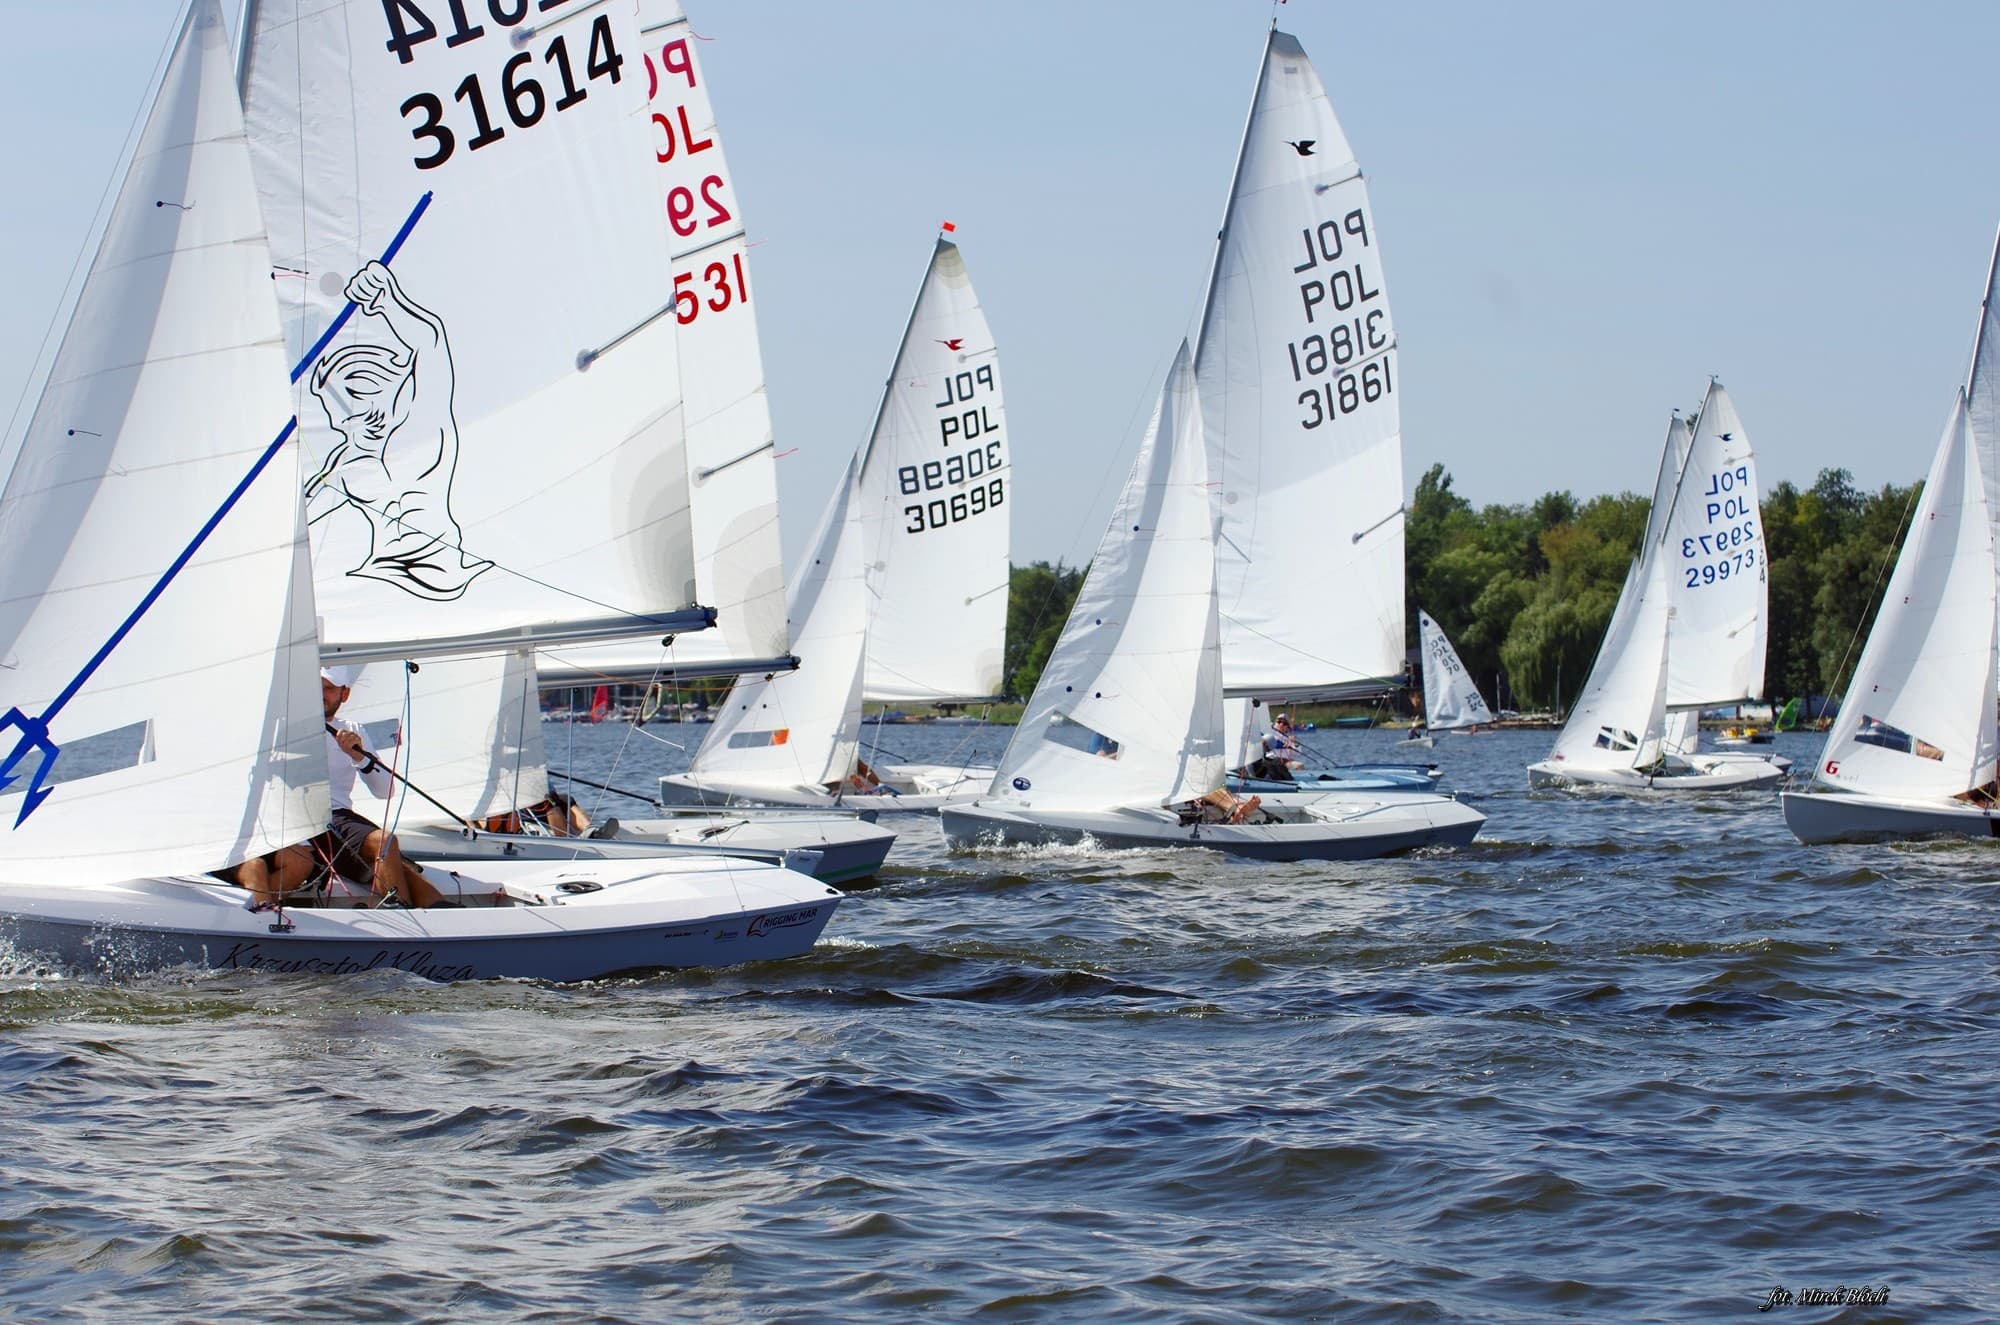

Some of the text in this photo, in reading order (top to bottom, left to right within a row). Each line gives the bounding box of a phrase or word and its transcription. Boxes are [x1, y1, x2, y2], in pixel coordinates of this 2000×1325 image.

[400, 14, 624, 170] 31614
[1300, 263, 1379, 324] POL
[1298, 355, 1392, 430] 31861
[940, 405, 999, 447] POL
[904, 478, 1004, 534] 30698
[1707, 495, 1749, 524] POL
[1686, 548, 1754, 588] 29973
[764, 907, 818, 928] RIGGING MAR
